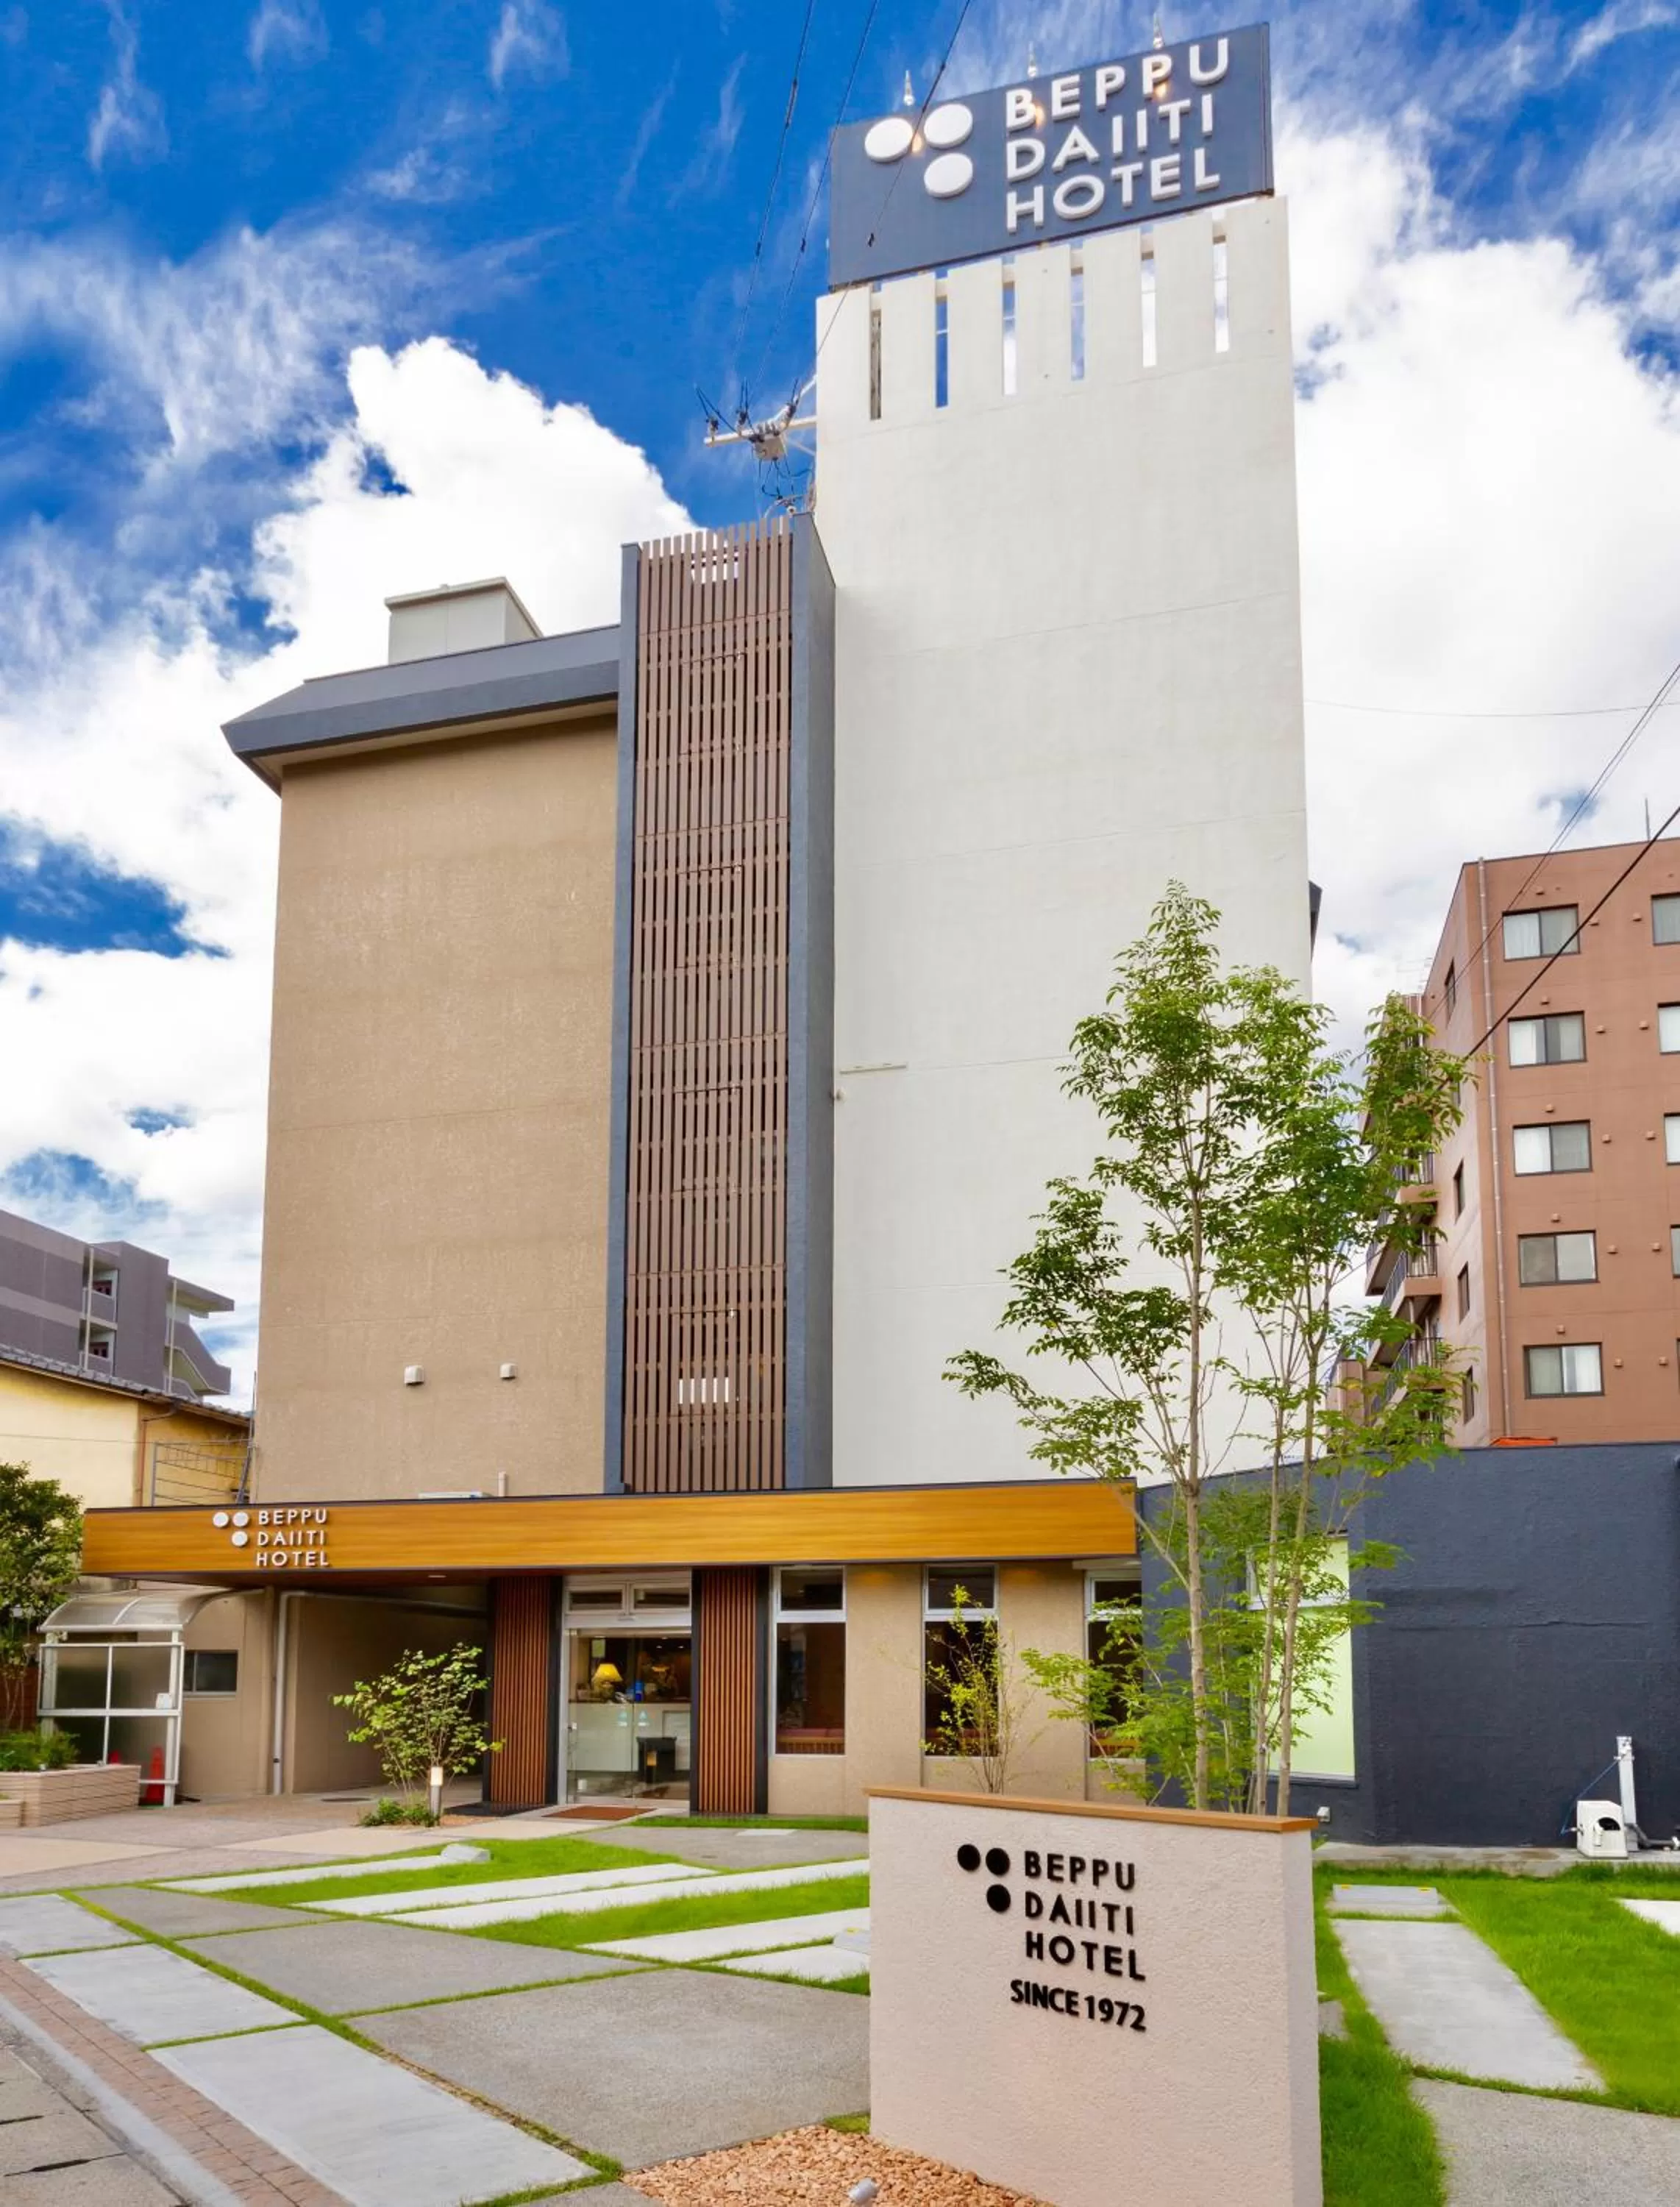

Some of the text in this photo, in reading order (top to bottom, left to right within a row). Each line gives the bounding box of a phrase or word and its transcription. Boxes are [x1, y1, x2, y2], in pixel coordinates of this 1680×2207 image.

[1005, 38, 1229, 132] BEPPU
[1005, 94, 1213, 183] DAIITI
[1005, 148, 1220, 234] HOTEL
[257, 1530, 324, 1546] DAIITI
[258, 1509, 327, 1525] BEPPU
[256, 1551, 329, 1566] HOTEL
[1025, 1850, 1136, 1891] BEPPU
[1025, 1891, 1134, 1936] DAIITI
[1025, 1930, 1146, 1981] HOTEL
[1010, 1979, 1147, 2032] SINCE 1972
